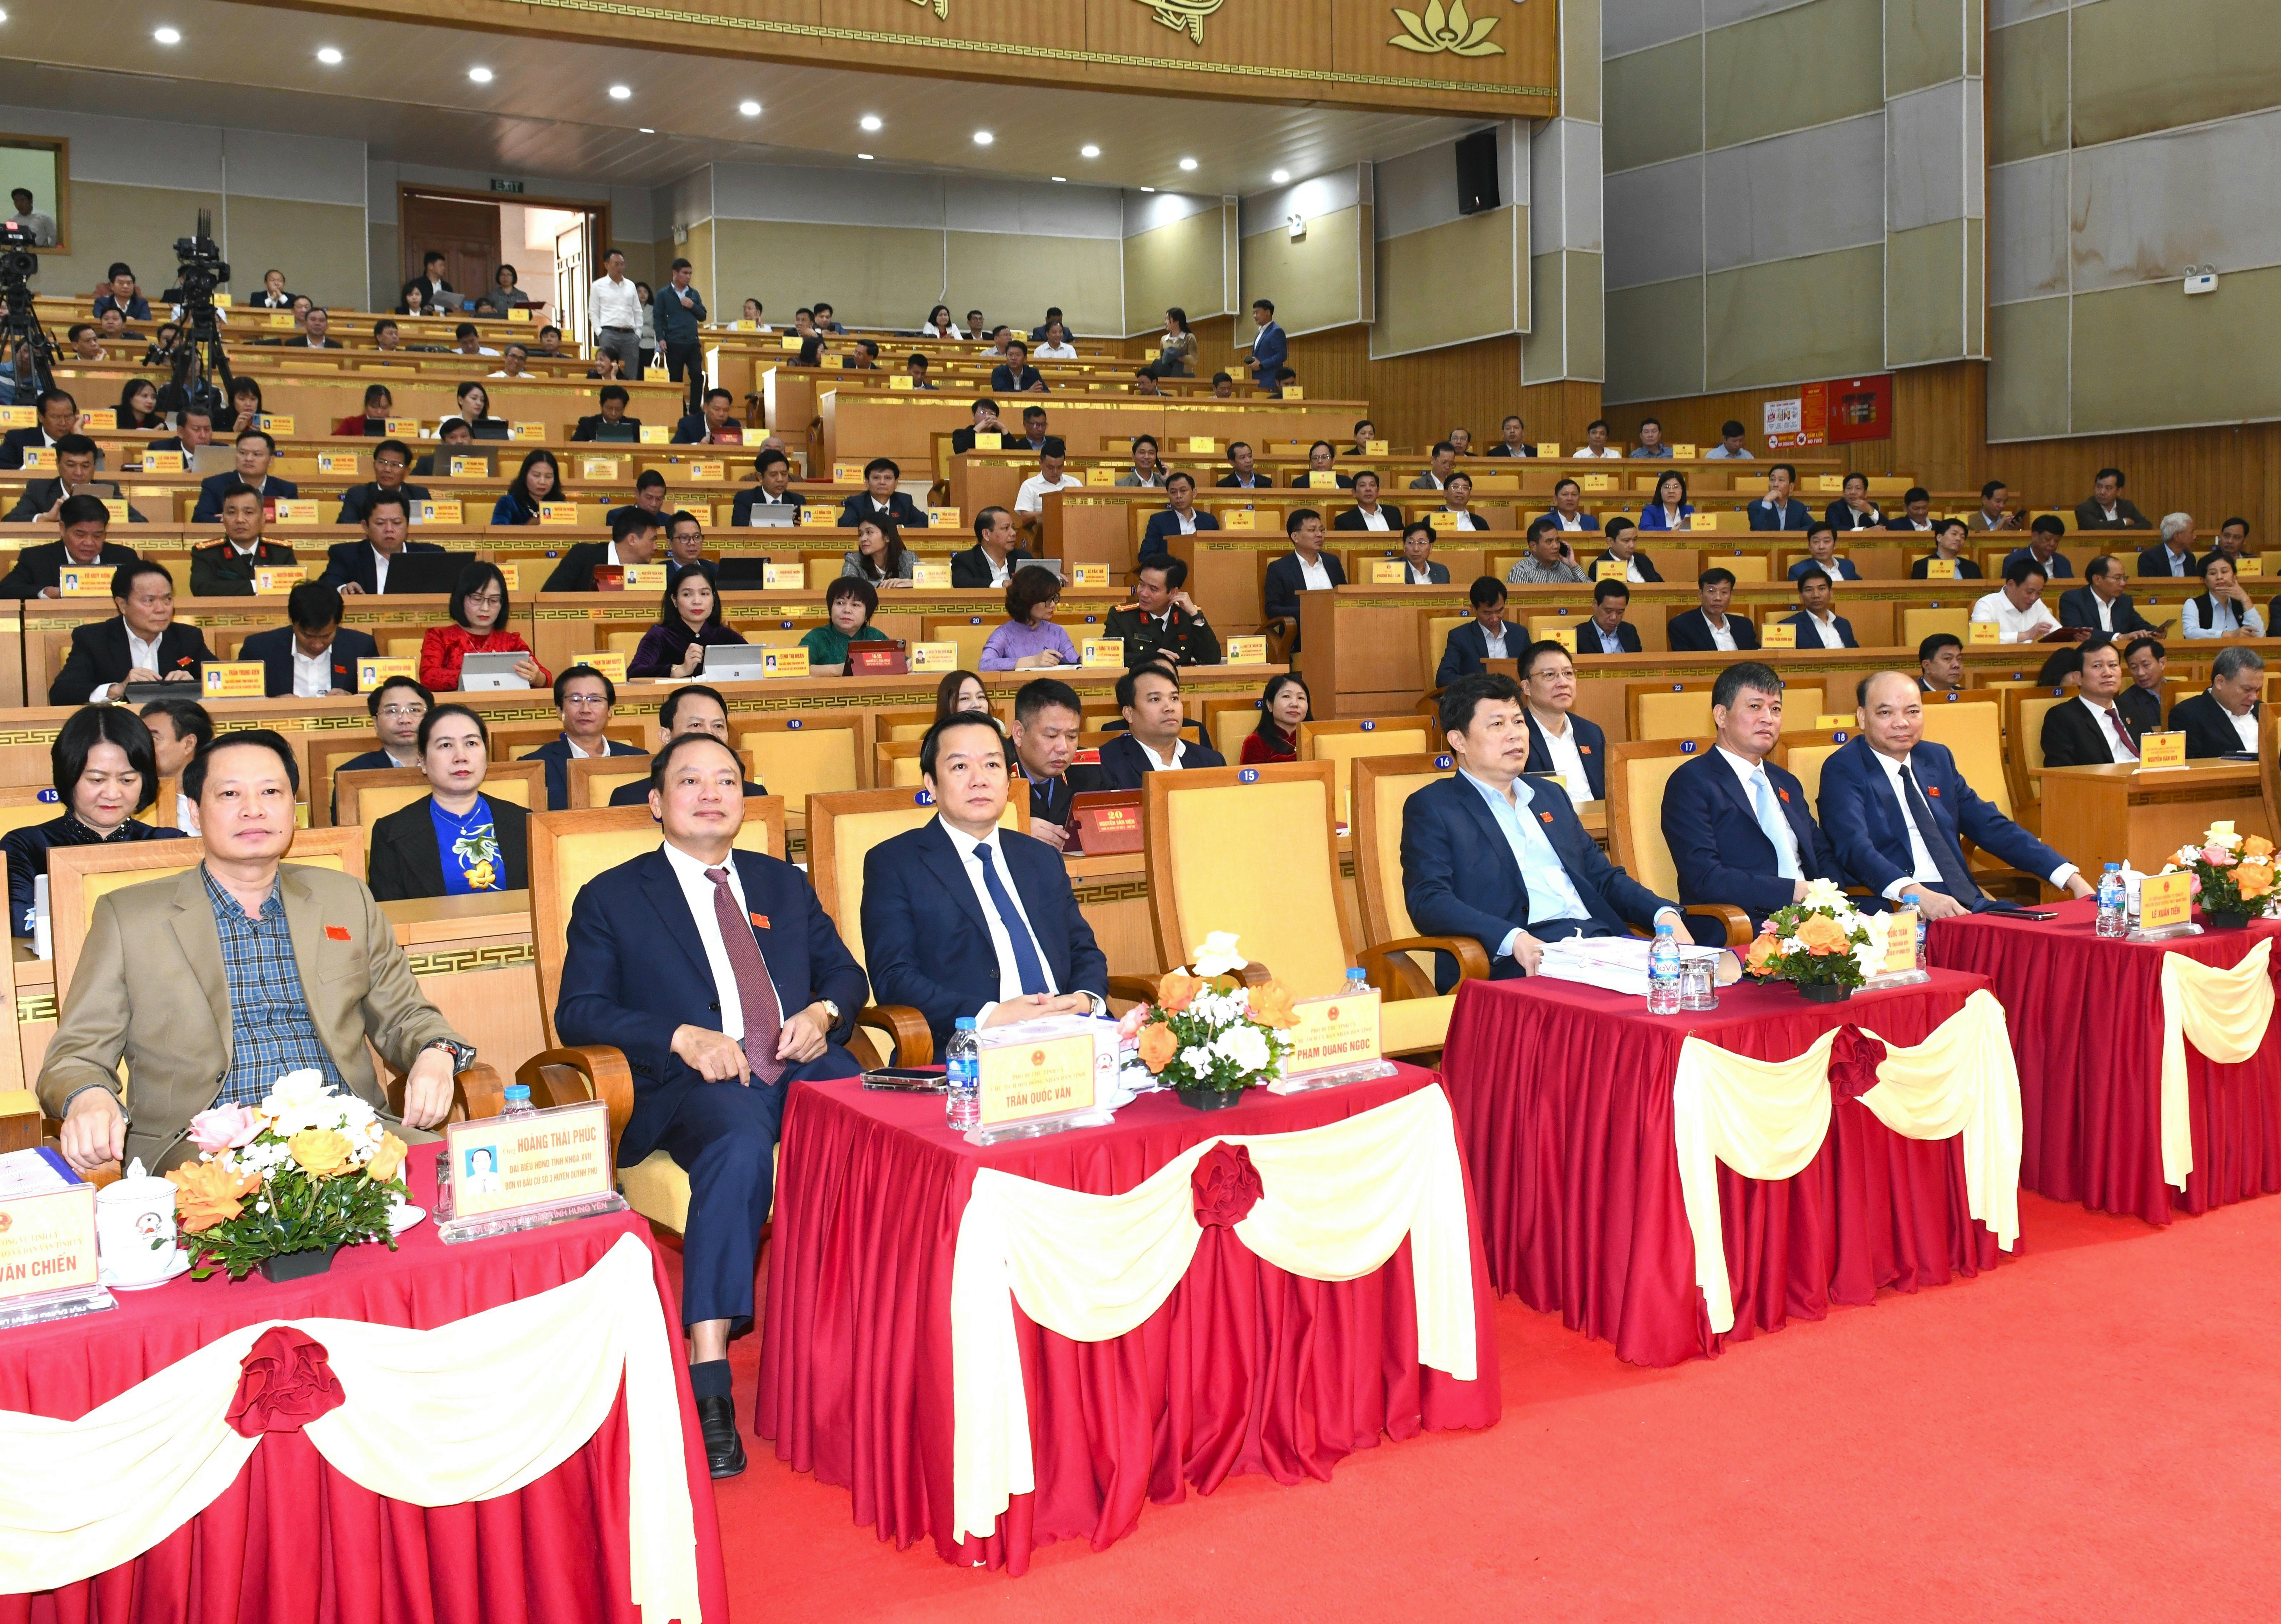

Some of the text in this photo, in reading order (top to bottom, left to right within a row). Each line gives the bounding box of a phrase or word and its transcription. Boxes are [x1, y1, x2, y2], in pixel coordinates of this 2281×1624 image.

[496, 180, 519, 192] EXIT
[1837, 733, 1845, 742] 18
[1685, 742, 1694, 751] 17
[1440, 757, 1449, 766] 16
[1244, 771, 1255, 781] 15
[45, 791, 59, 801] 13
[922, 792, 932, 803] 14
[1108, 811, 1123, 819] 20
[2152, 904, 2180, 919] LÊ XUÂN TIẾN
[1297, 1038, 1370, 1061] PHẠM QUANG NGỌC
[1006, 1085, 1071, 1108] TRẦN QUỐC VĂN
[518, 1124, 597, 1153] HOÀNG THÁI PHÚC
[510, 1164, 519, 1175] ĐẠI
[520, 1159, 533, 1172] BIỂU
[534, 1159, 550, 1170] HĐND
[551, 1155, 564, 1167] TỈNH
[581, 1152, 592, 1161] XVII
[505, 1181, 515, 1190] ĐƠN
[516, 1179, 521, 1189] VỊ
[523, 1176, 533, 1187] BẦU
[534, 1175, 541, 1185] CỬ
[541, 1172, 548, 1184] SỐ
[549, 1174, 553, 1183] 3
[553, 1171, 570, 1182] HUYỆN
[551, 1208, 568, 1219] TỈNH
[568, 1203, 591, 1215] HƯNG
[591, 1201, 608, 1212] YÊN
[31, 1252, 76, 1277] CHIẾN
